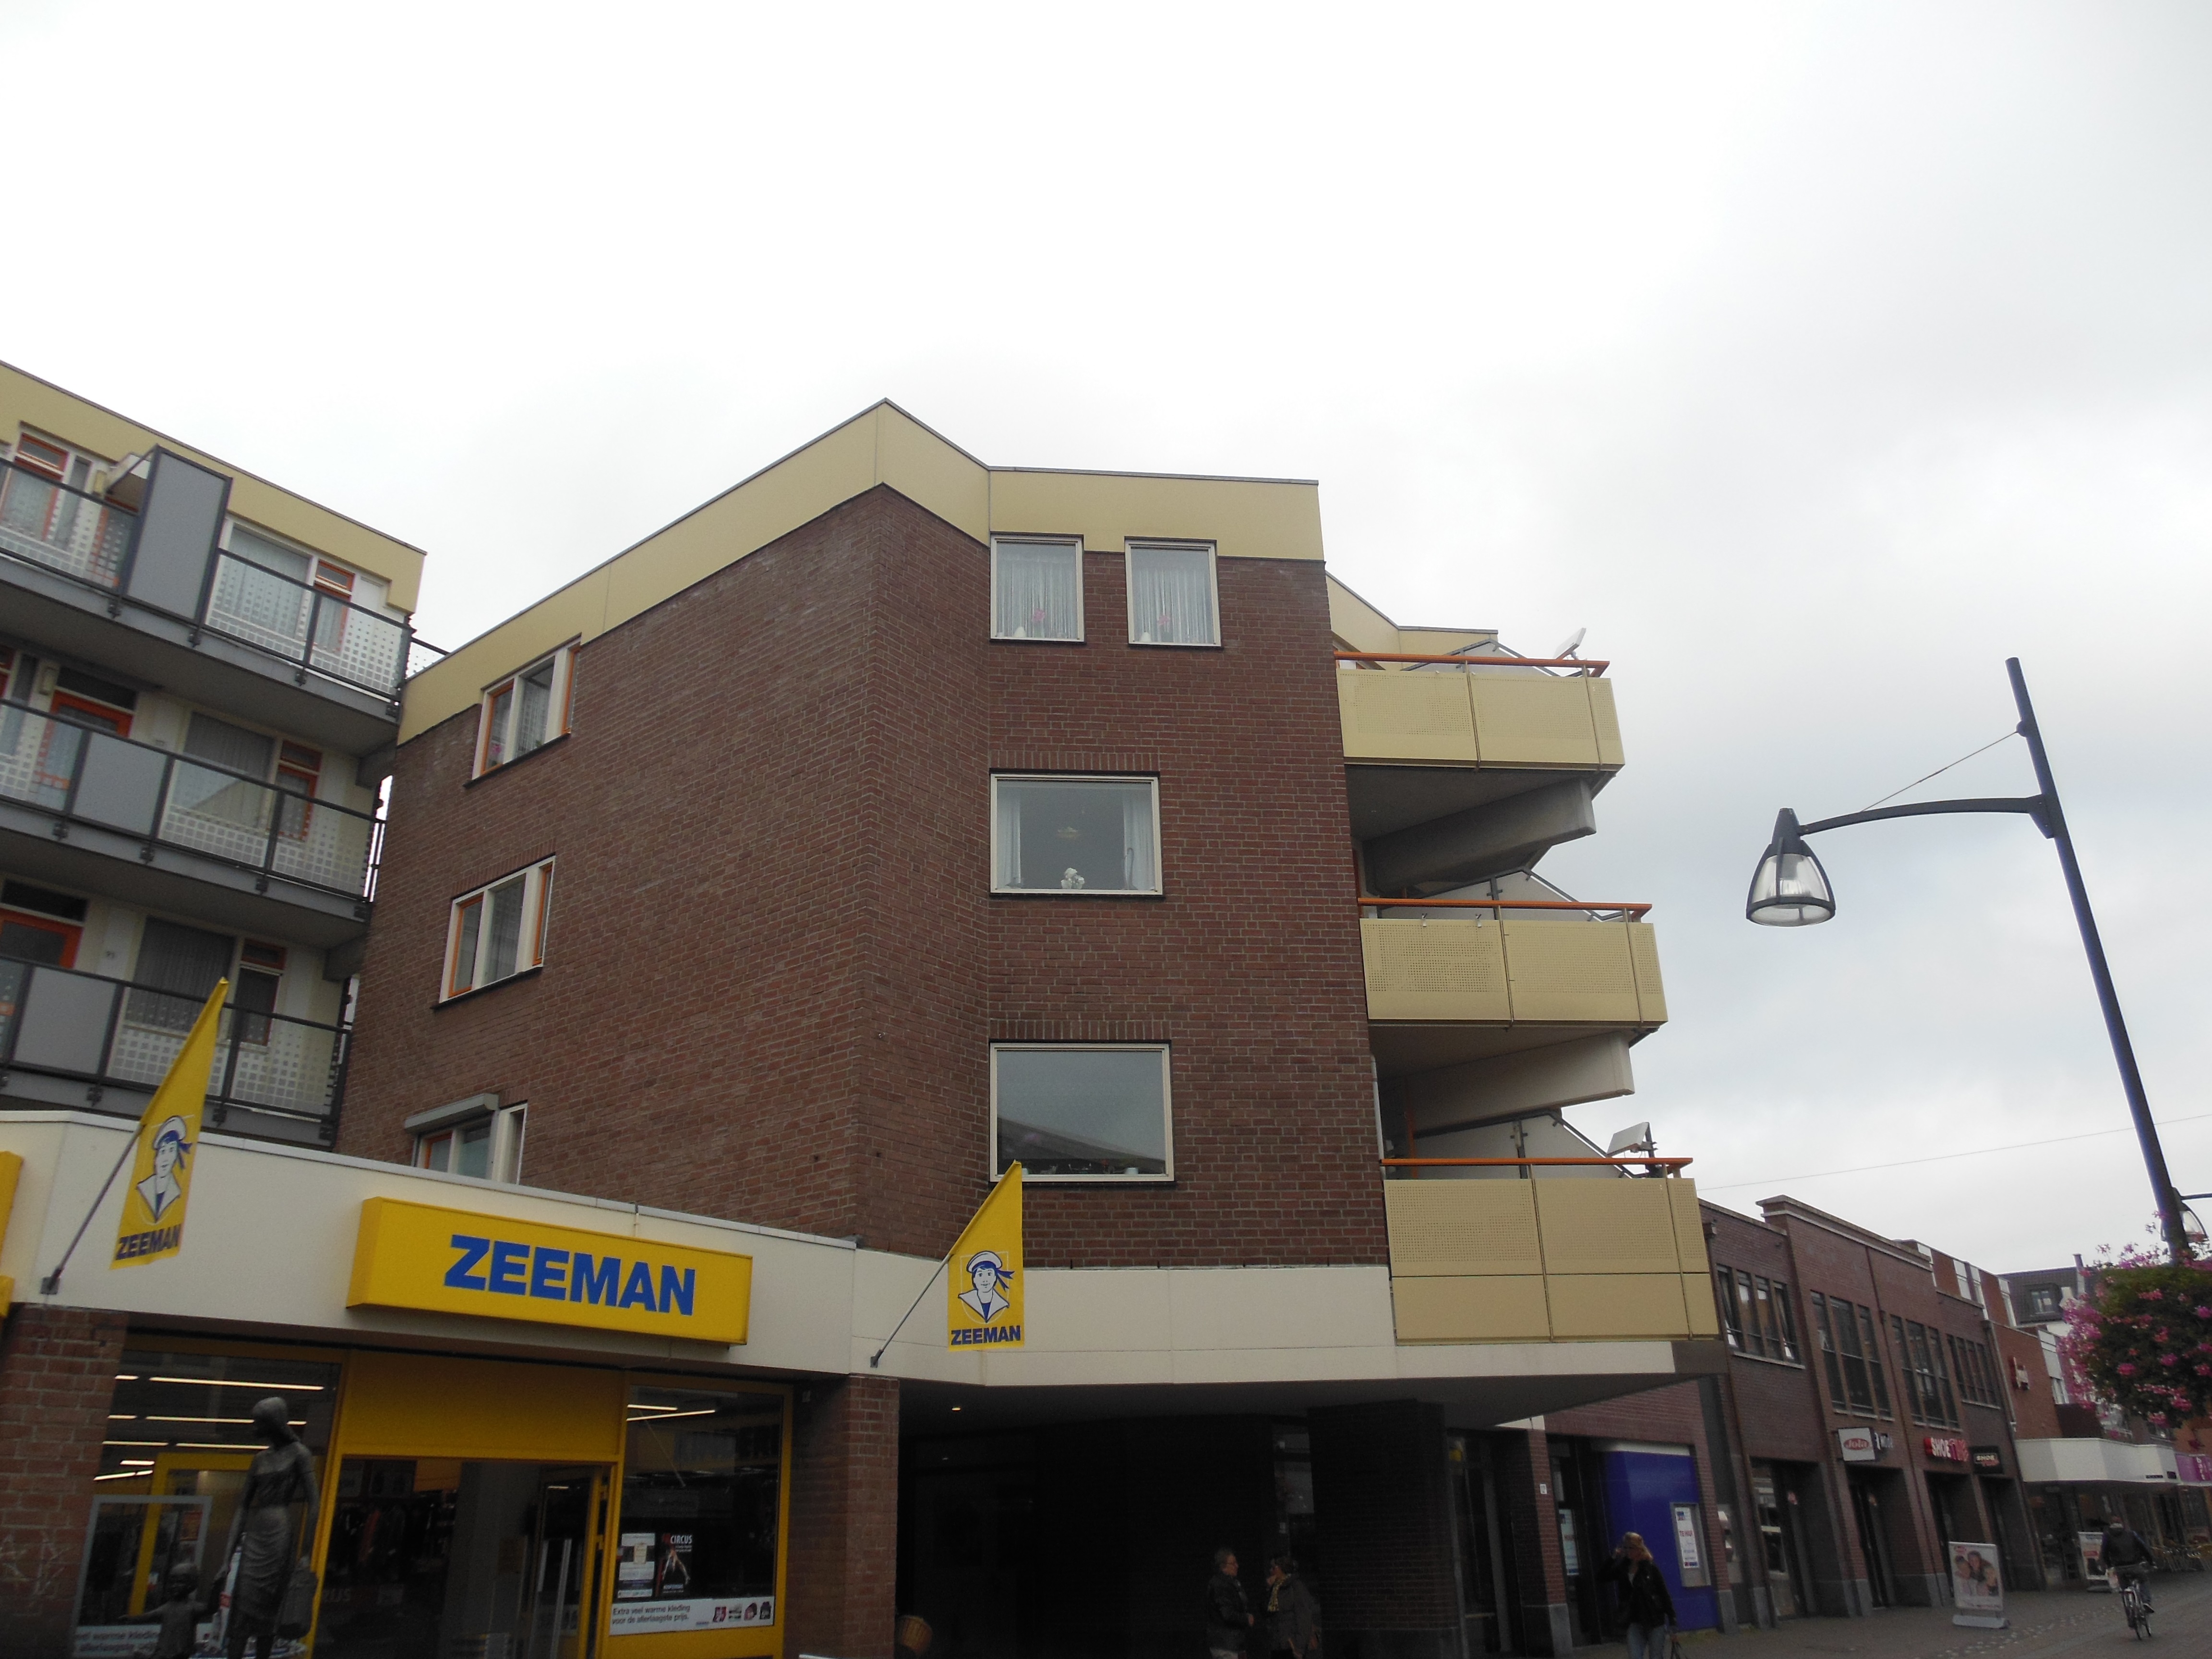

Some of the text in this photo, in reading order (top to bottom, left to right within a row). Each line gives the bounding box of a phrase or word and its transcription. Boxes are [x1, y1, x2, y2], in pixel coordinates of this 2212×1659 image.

[116, 1223, 181, 1260] ZEEMAN
[444, 1234, 696, 1316] ZEEMAN
[950, 1325, 1021, 1346] ZEEMAN
[670, 1535, 692, 1544] CIRCUS
[668, 1604, 690, 1612] kleding
[637, 1614, 673, 1623] allerlaagste
